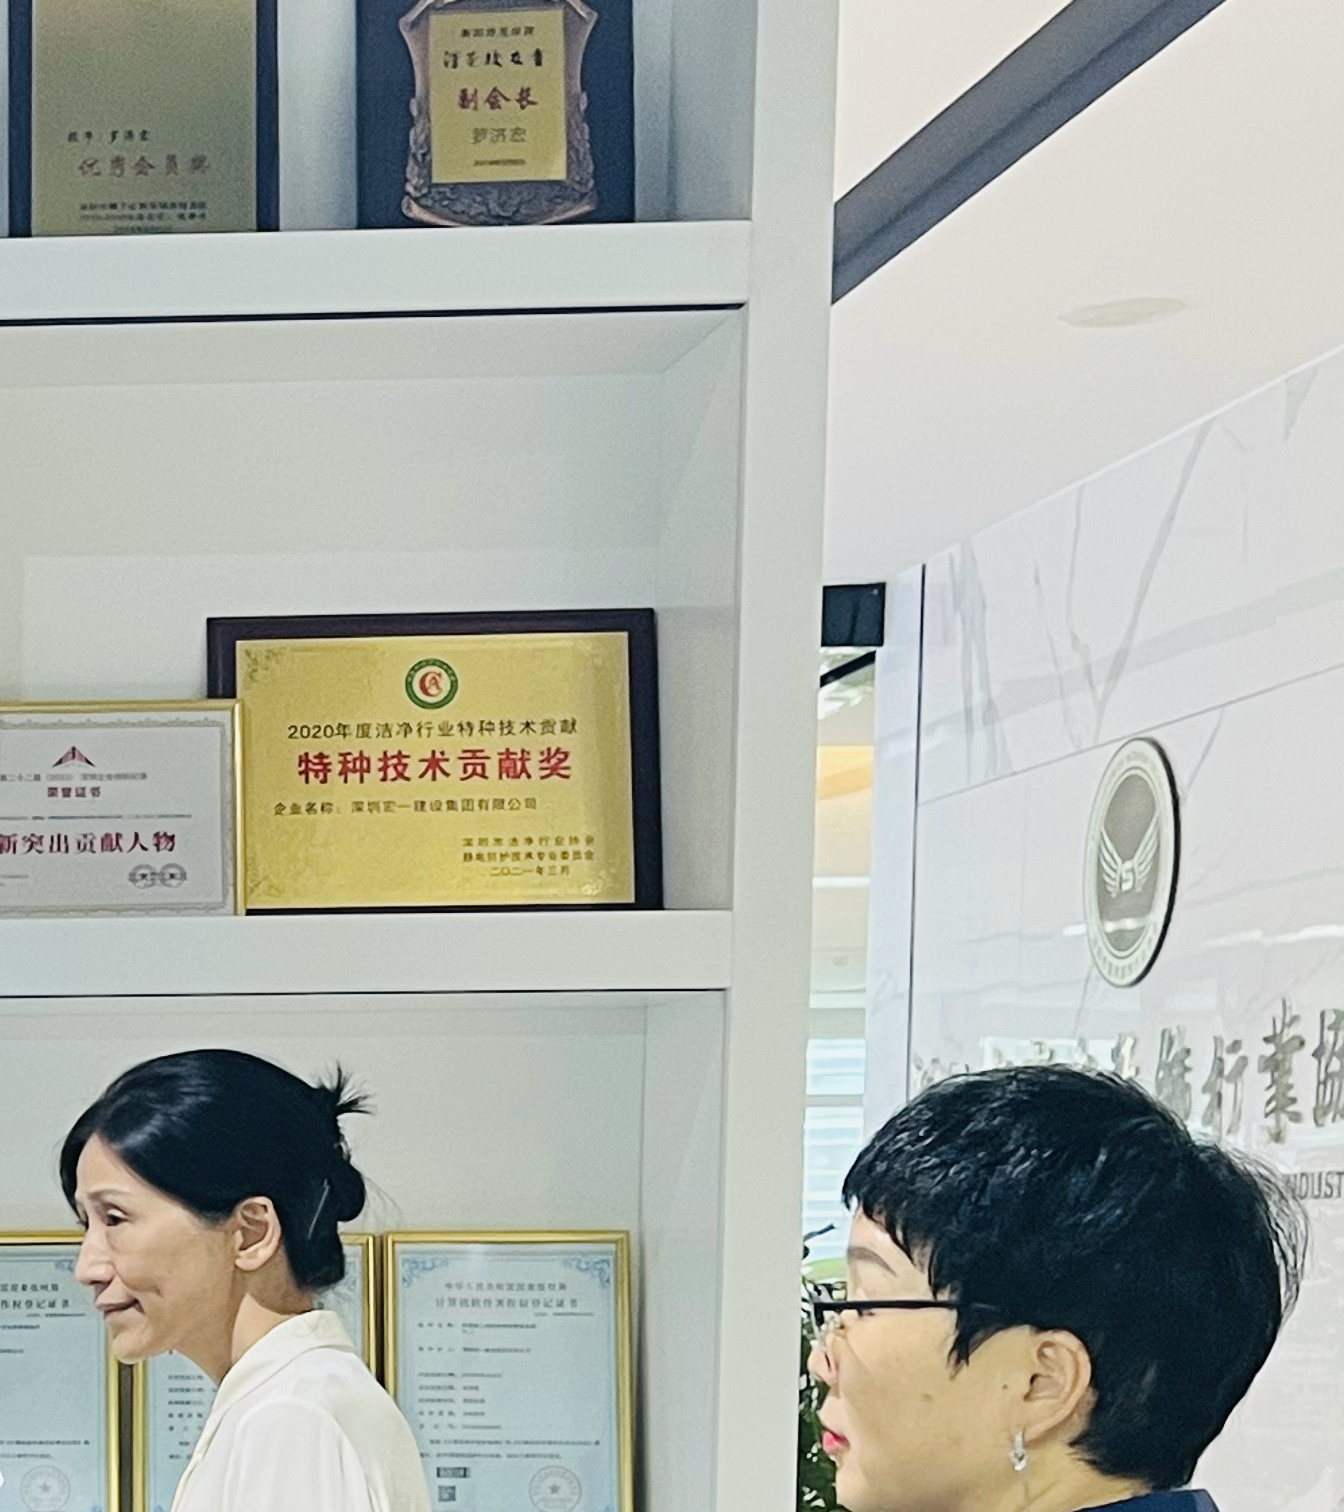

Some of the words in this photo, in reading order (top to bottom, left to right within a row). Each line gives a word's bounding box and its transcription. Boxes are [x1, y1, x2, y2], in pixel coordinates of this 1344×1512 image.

[287, 717, 578, 740] 2020年度洁净行业特种技术贡献
[298, 747, 572, 785] 特种技术贡献奖
